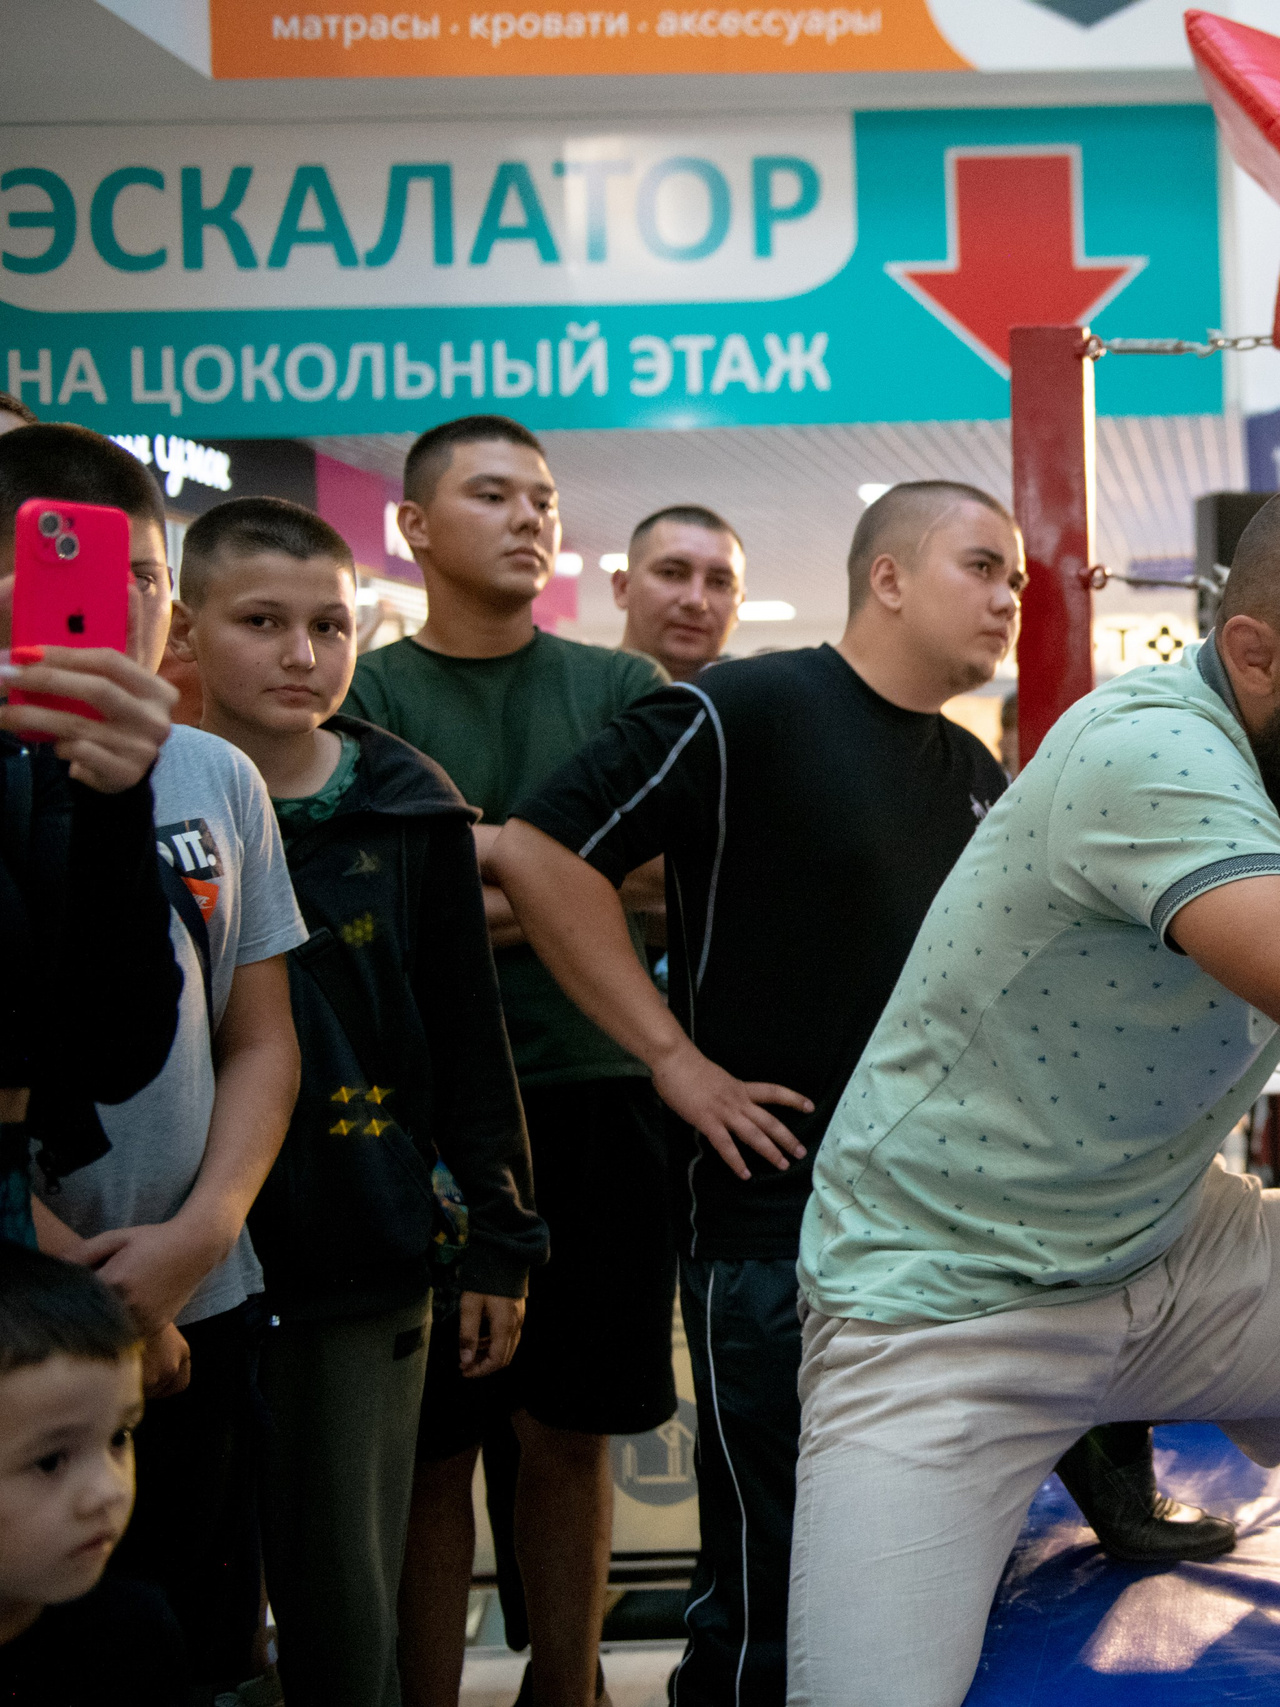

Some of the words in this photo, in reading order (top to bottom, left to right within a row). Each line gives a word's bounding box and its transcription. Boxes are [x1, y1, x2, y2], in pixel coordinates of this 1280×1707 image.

[271, 14, 441, 48] матрасы
[468, 11, 629, 47] кровати
[655, 6, 883, 46] аксессуары
[0, 155, 823, 275] ЭСКАЛАТОР
[7, 346, 107, 407] НА
[130, 322, 608, 417] ЦОКОЛЬНЫЙ
[629, 333, 833, 397] ЭТАЖ
